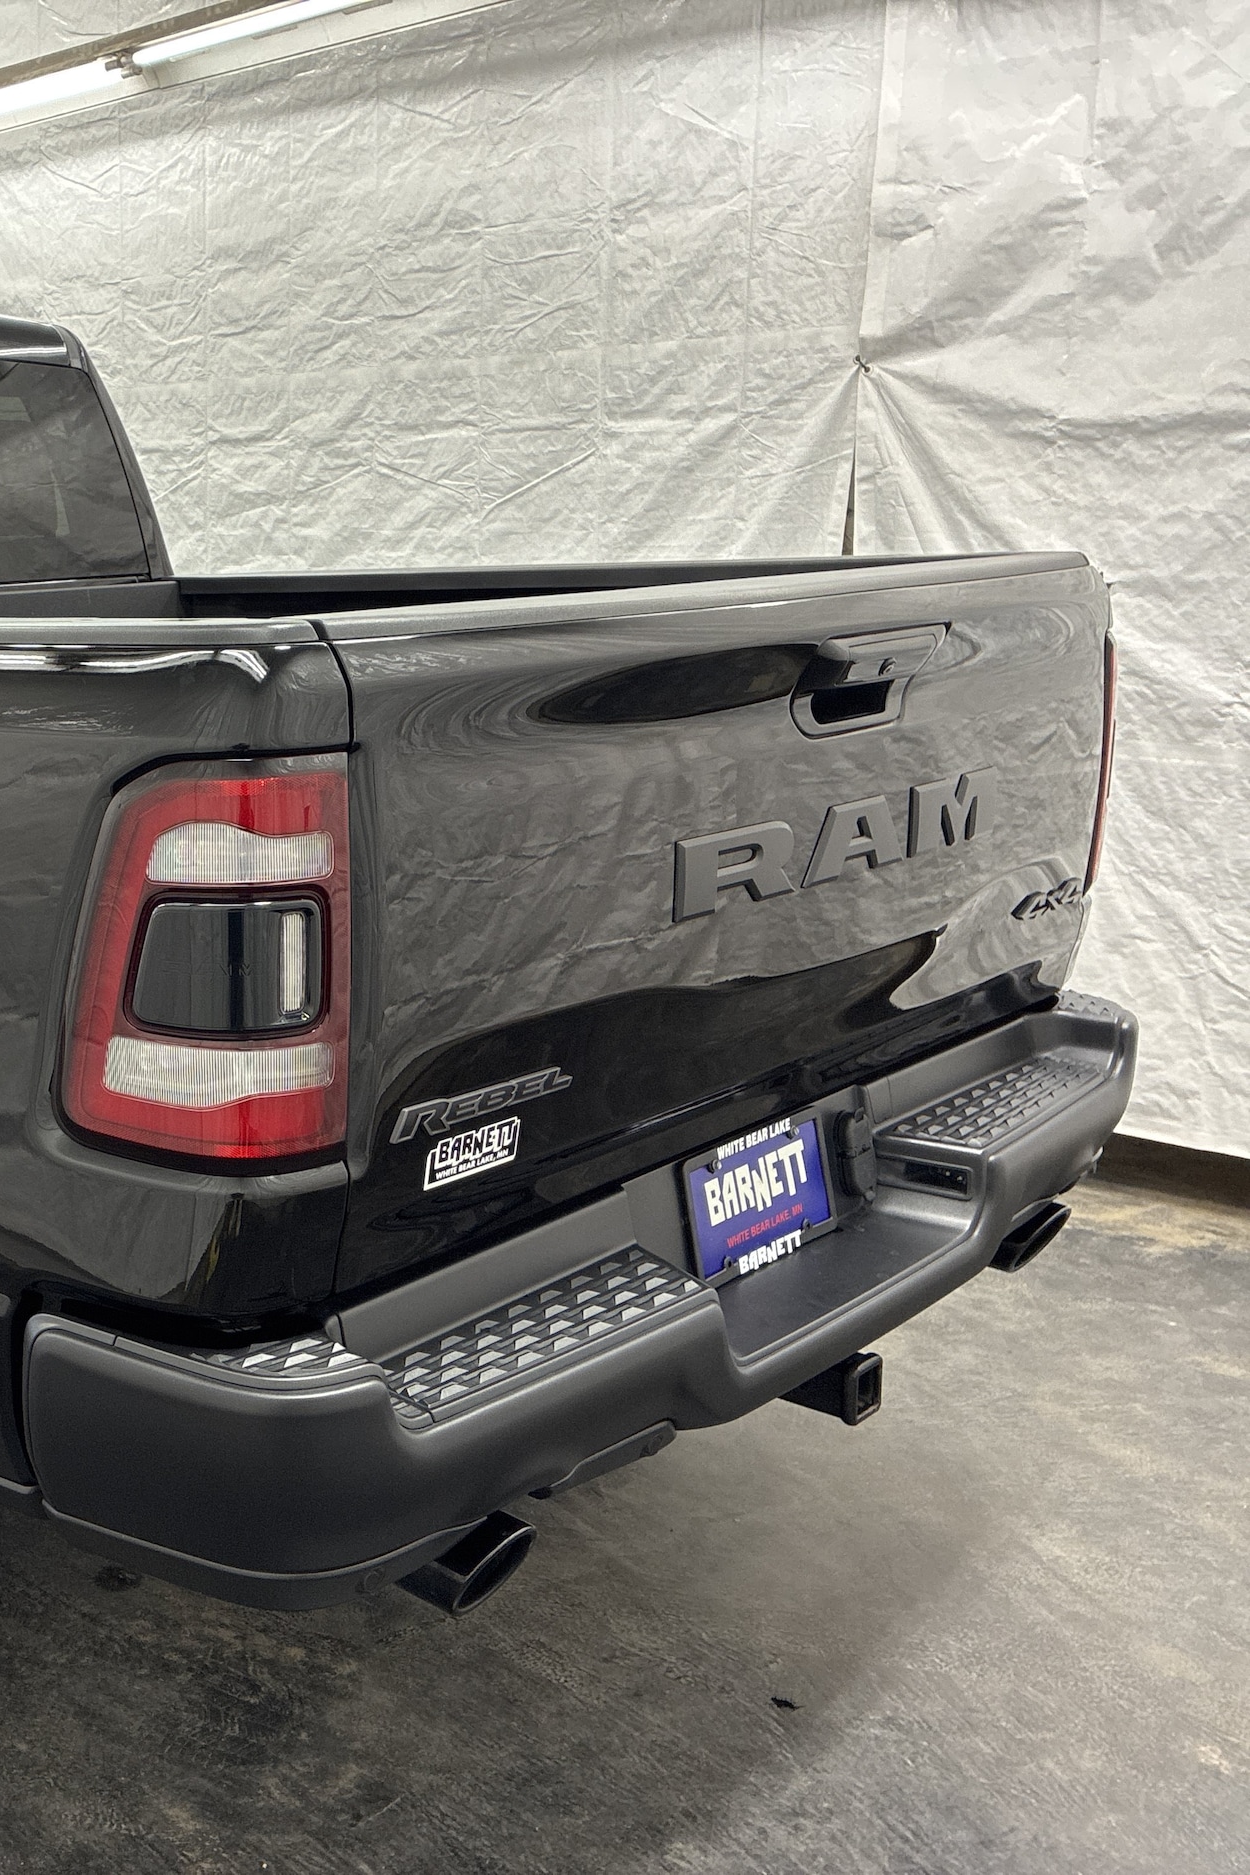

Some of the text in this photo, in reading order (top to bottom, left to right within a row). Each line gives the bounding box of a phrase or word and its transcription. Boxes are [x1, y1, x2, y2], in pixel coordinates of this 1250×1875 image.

[672, 765, 998, 923] RAM
[389, 1066, 573, 1144] REBEL
[439, 1119, 516, 1163] BARNETT
[716, 1117, 791, 1160] WHITE BEAR LAKE
[435, 1167, 457, 1180] WHITE
[458, 1161, 476, 1174] BEAR
[496, 1147, 509, 1160] MN
[704, 1138, 808, 1227] BARNETT
[726, 1229, 750, 1249] WHITE
[750, 1220, 771, 1238] BEAR
[791, 1203, 803, 1217] MN
[738, 1229, 802, 1275] BARNETT
